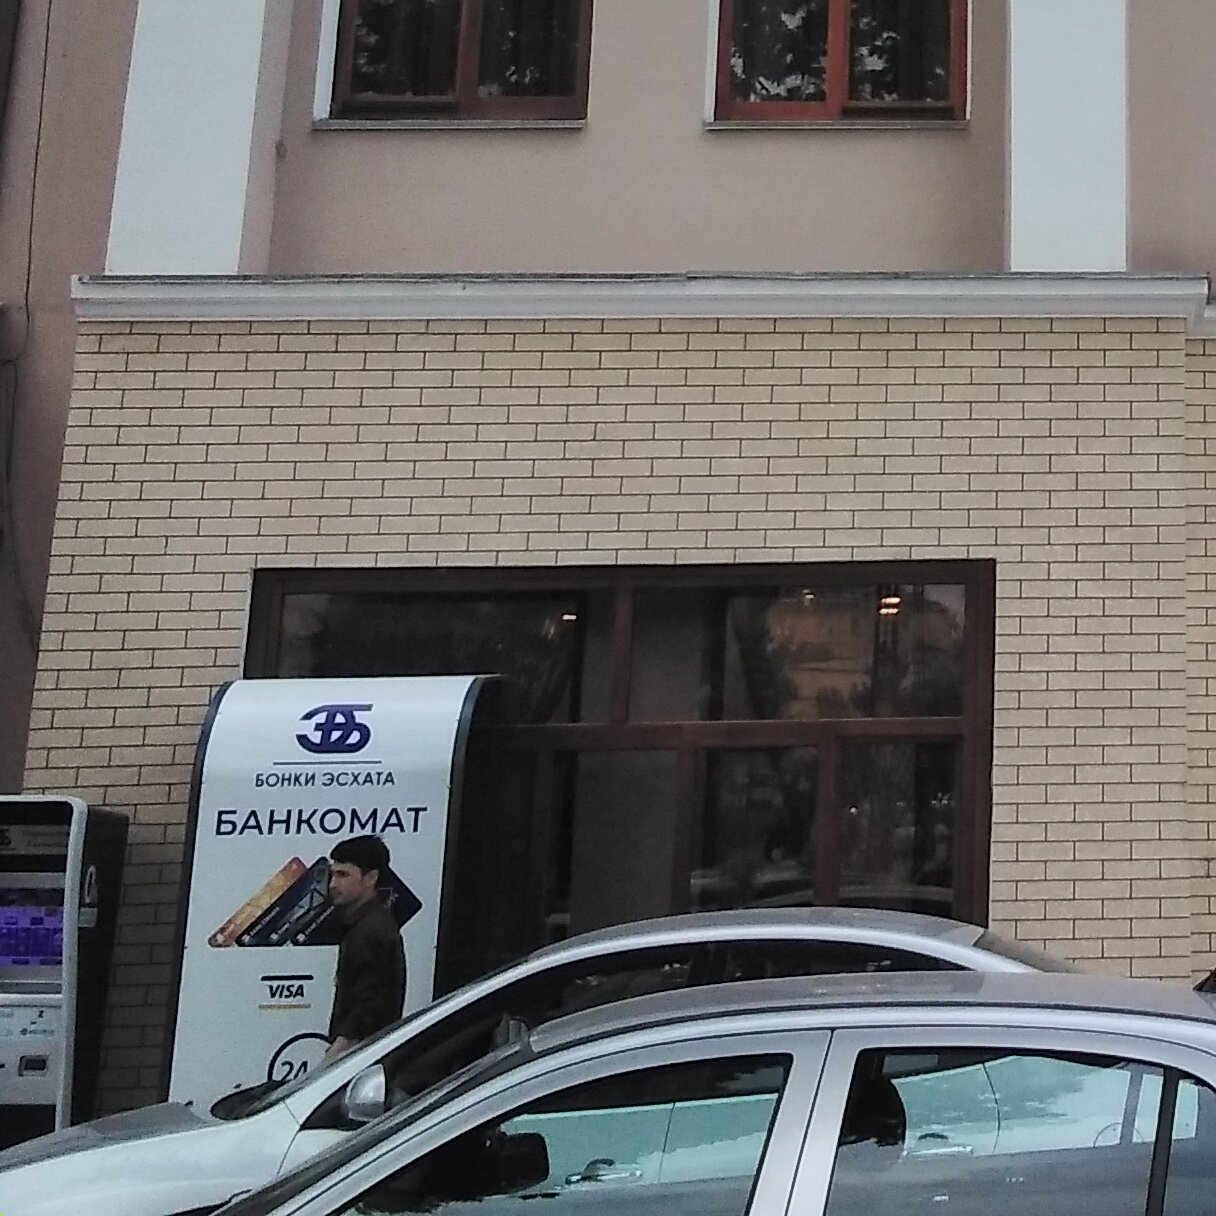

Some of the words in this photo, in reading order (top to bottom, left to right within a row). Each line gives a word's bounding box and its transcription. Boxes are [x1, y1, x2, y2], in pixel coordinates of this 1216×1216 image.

[255, 772, 316, 788] БОНКИ
[322, 771, 396, 787] ЭСХАТА
[215, 806, 429, 836] БАНКОМАТ
[268, 984, 305, 999] VISA
